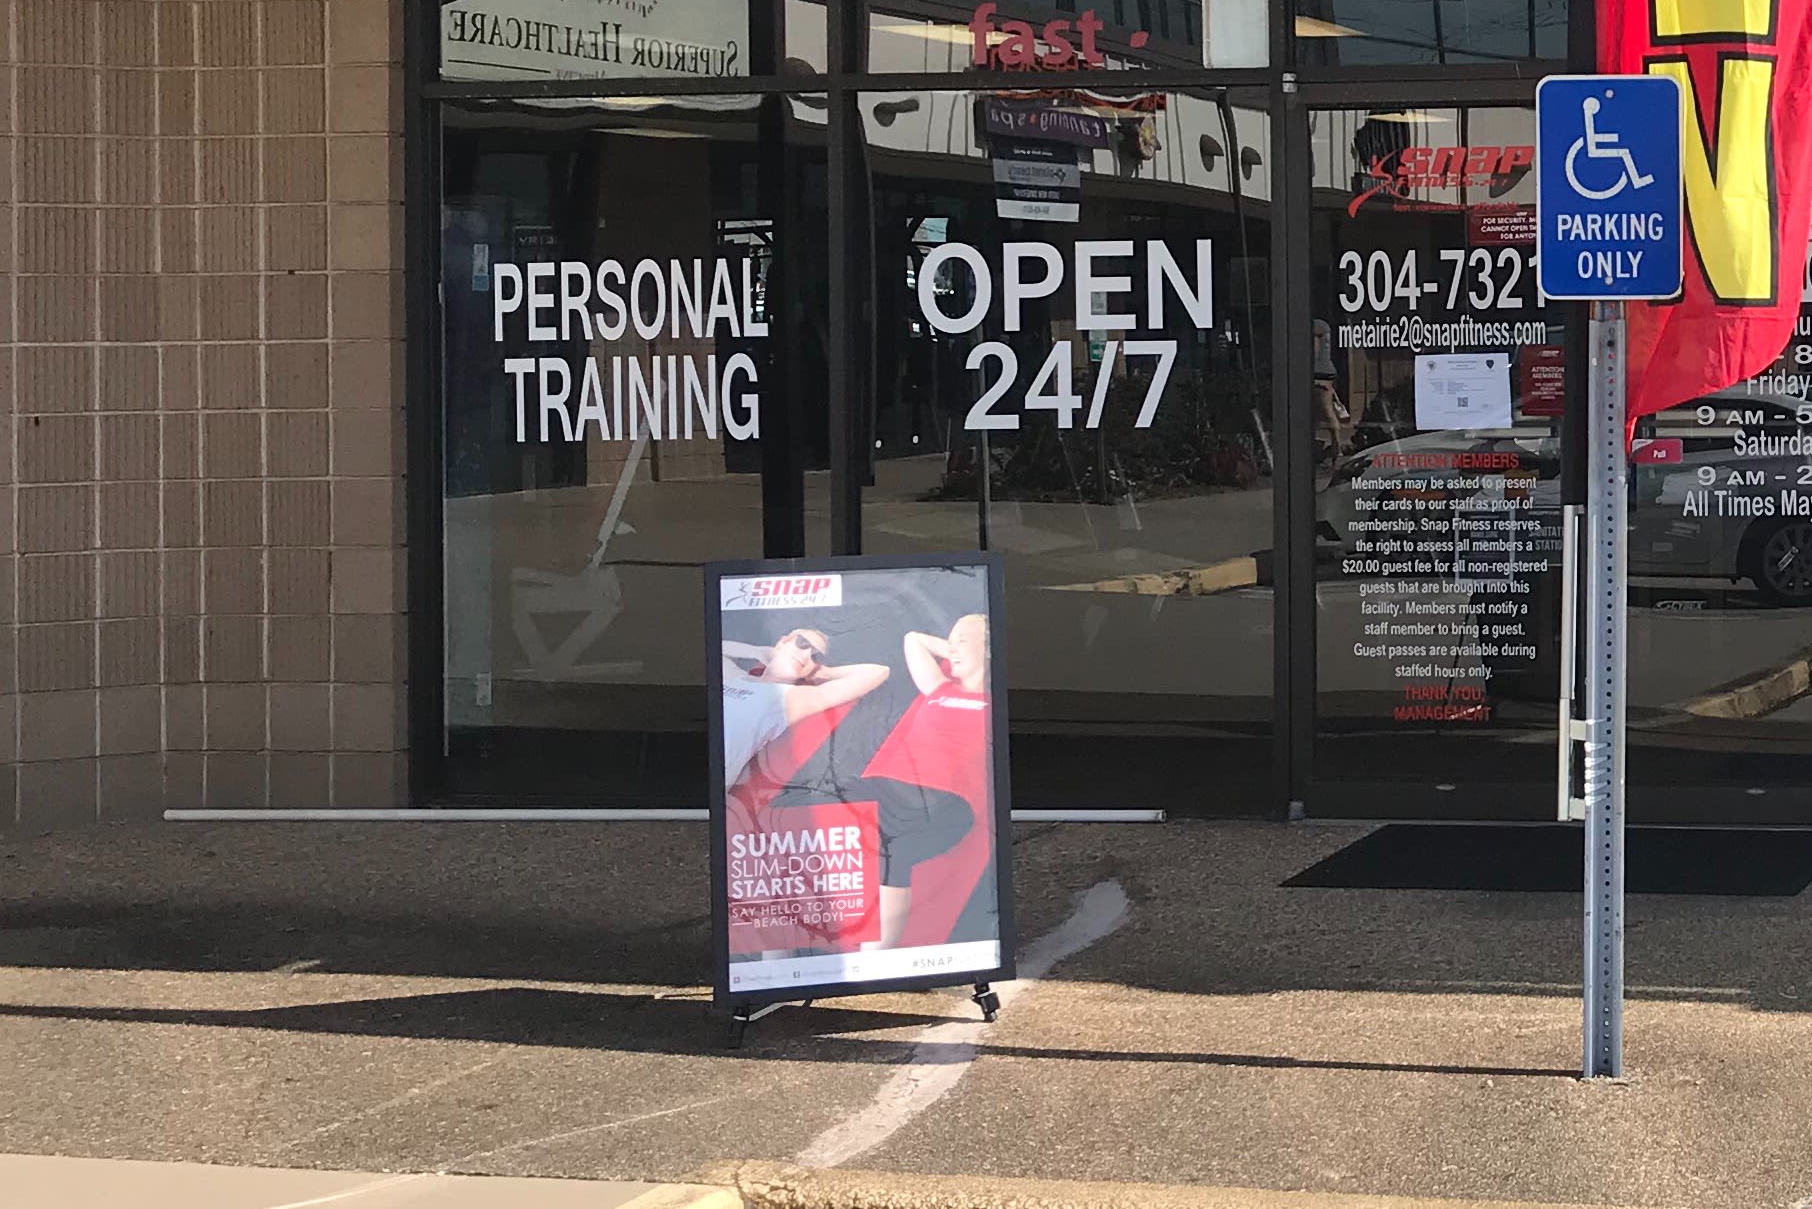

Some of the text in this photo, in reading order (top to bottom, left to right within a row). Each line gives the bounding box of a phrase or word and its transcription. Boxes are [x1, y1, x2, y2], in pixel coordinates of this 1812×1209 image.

[968, 2, 1105, 65] fast
[1557, 213, 1664, 241] PARKING
[1577, 250, 1643, 279] ONLY
[917, 238, 1214, 335] OPEN
[494, 257, 769, 342] PERSONAL
[1338, 315, 1546, 353] metairie2@snapfitness.com
[964, 339, 1178, 430] 24/7
[1746, 369, 1811, 402] Friday
[504, 352, 760, 444] TRAINING
[1696, 405, 1715, 426] 9
[1726, 410, 1764, 425] AM
[1373, 454, 1520, 469] ATTENTION MEMBERS
[1352, 477, 1536, 491] Members asked present
[1697, 465, 1716, 486] 9
[1727, 470, 1765, 485] AM
[1355, 497, 1520, 512] their cards staff proof
[1683, 490, 1709, 517] All
[1714, 490, 1775, 517] Times
[1349, 518, 1540, 534] membership. Snap Fitness reserves
[1376, 539, 1523, 555] right assess members
[1342, 559, 1547, 575] $20.00 guest non-registered
[1360, 581, 1529, 596] guests that brought into this
[1406, 602, 1518, 617] Members must notify
[1364, 622, 1388, 635] staff
[1391, 622, 1435, 635] member
[1452, 622, 1479, 637] bring
[1354, 643, 1536, 659] Guest passes are available during
[1395, 664, 1431, 676] staffed
[1434, 664, 1465, 677] hours
[731, 826, 862, 858] SUMMER
[731, 851, 863, 878] SLIM-DOWN
[731, 872, 863, 899] STARTS HERE
[732, 898, 863, 918] SAY HELLO TO YOUR
[754, 917, 798, 928] BEACH
